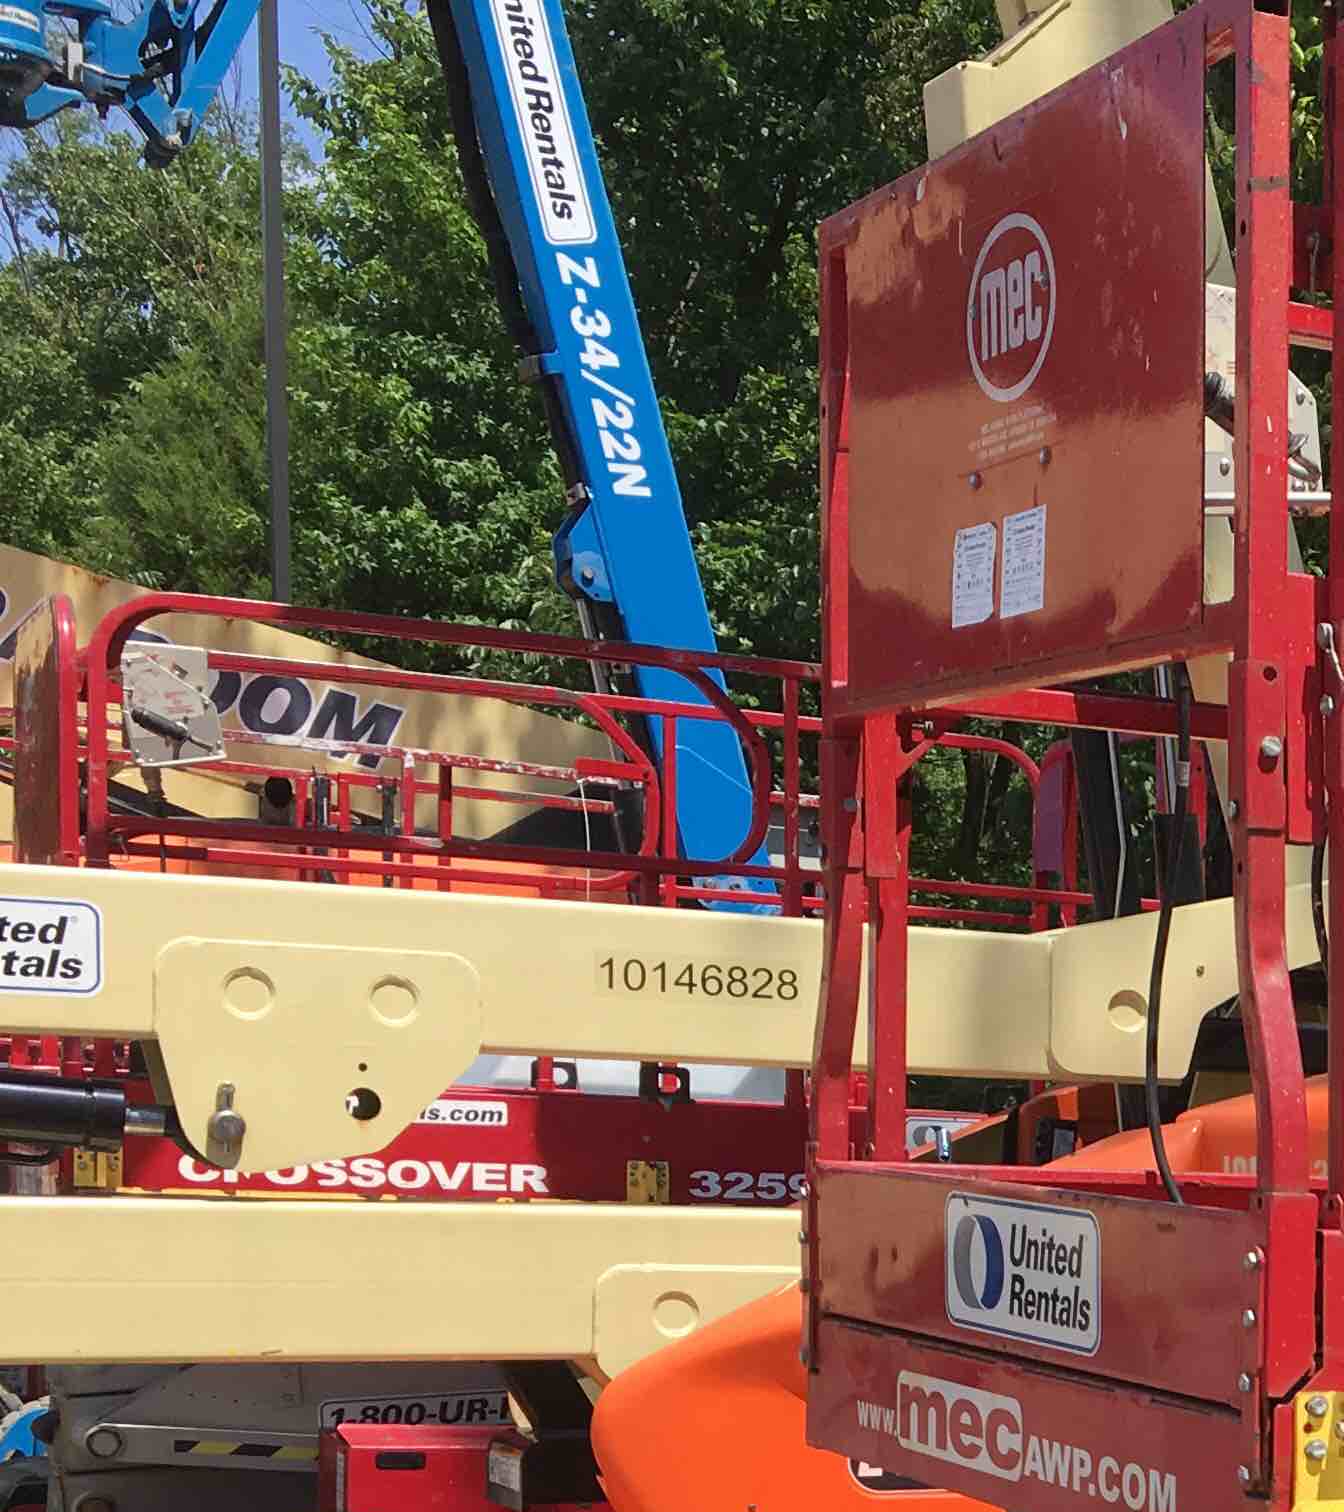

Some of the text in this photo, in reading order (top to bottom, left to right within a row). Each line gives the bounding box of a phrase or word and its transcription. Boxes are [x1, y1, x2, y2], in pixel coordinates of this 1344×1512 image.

[524, 87, 576, 220] Rentals
[555, 252, 652, 497] Z-34/22N
[600, 957, 799, 1000] 10146828
[177, 1154, 549, 1193] COSSOVER
[1009, 1223, 1084, 1279] United
[1009, 1274, 1091, 1331] Rentals
[331, 1398, 512, 1425] 1-800-UR-
